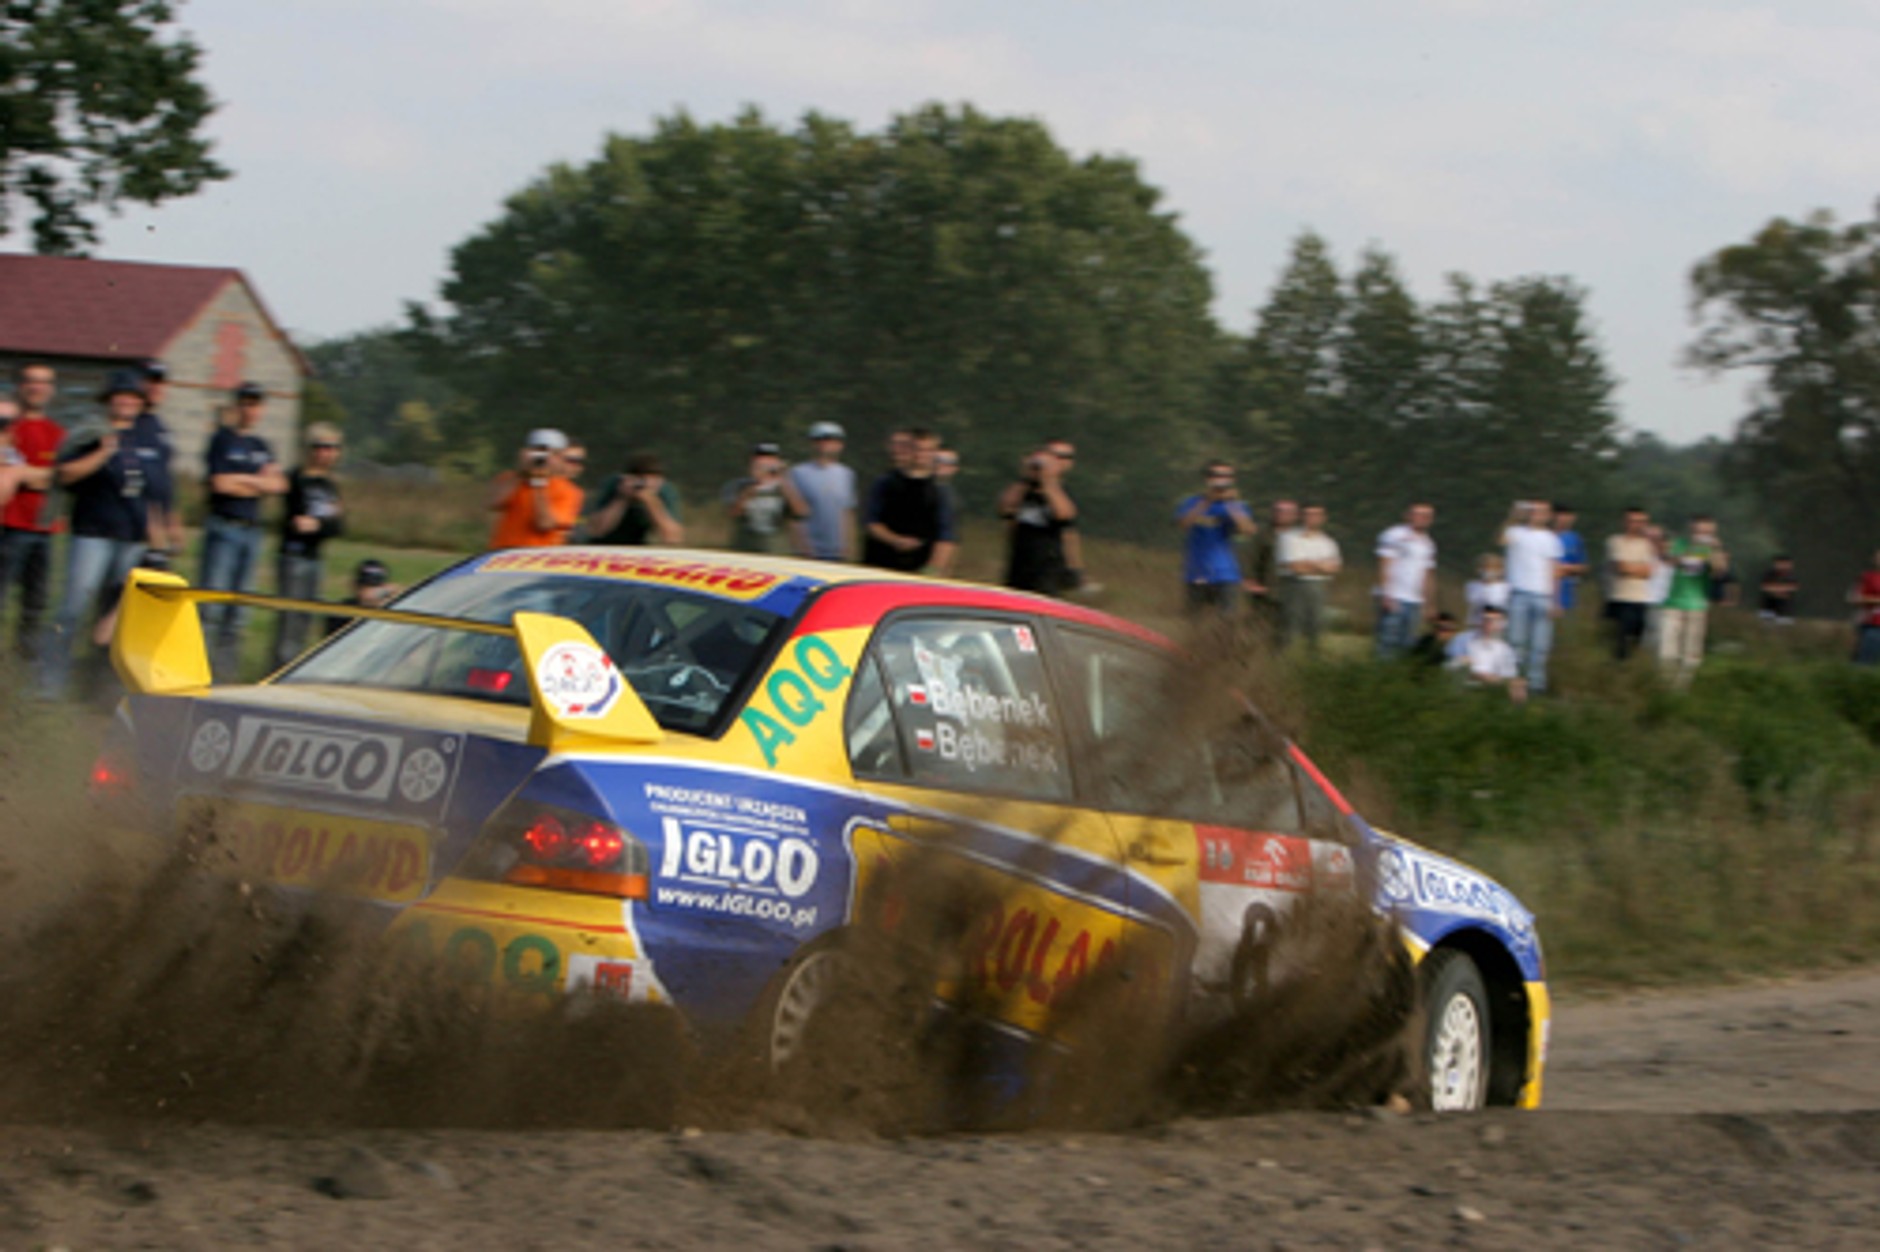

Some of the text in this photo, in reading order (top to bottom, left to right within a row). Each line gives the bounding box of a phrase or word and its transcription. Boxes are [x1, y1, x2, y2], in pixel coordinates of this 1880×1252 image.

[740, 635, 852, 768] AQQ
[234, 724, 388, 791] IGLOO
[660, 816, 818, 897] IGLOO
